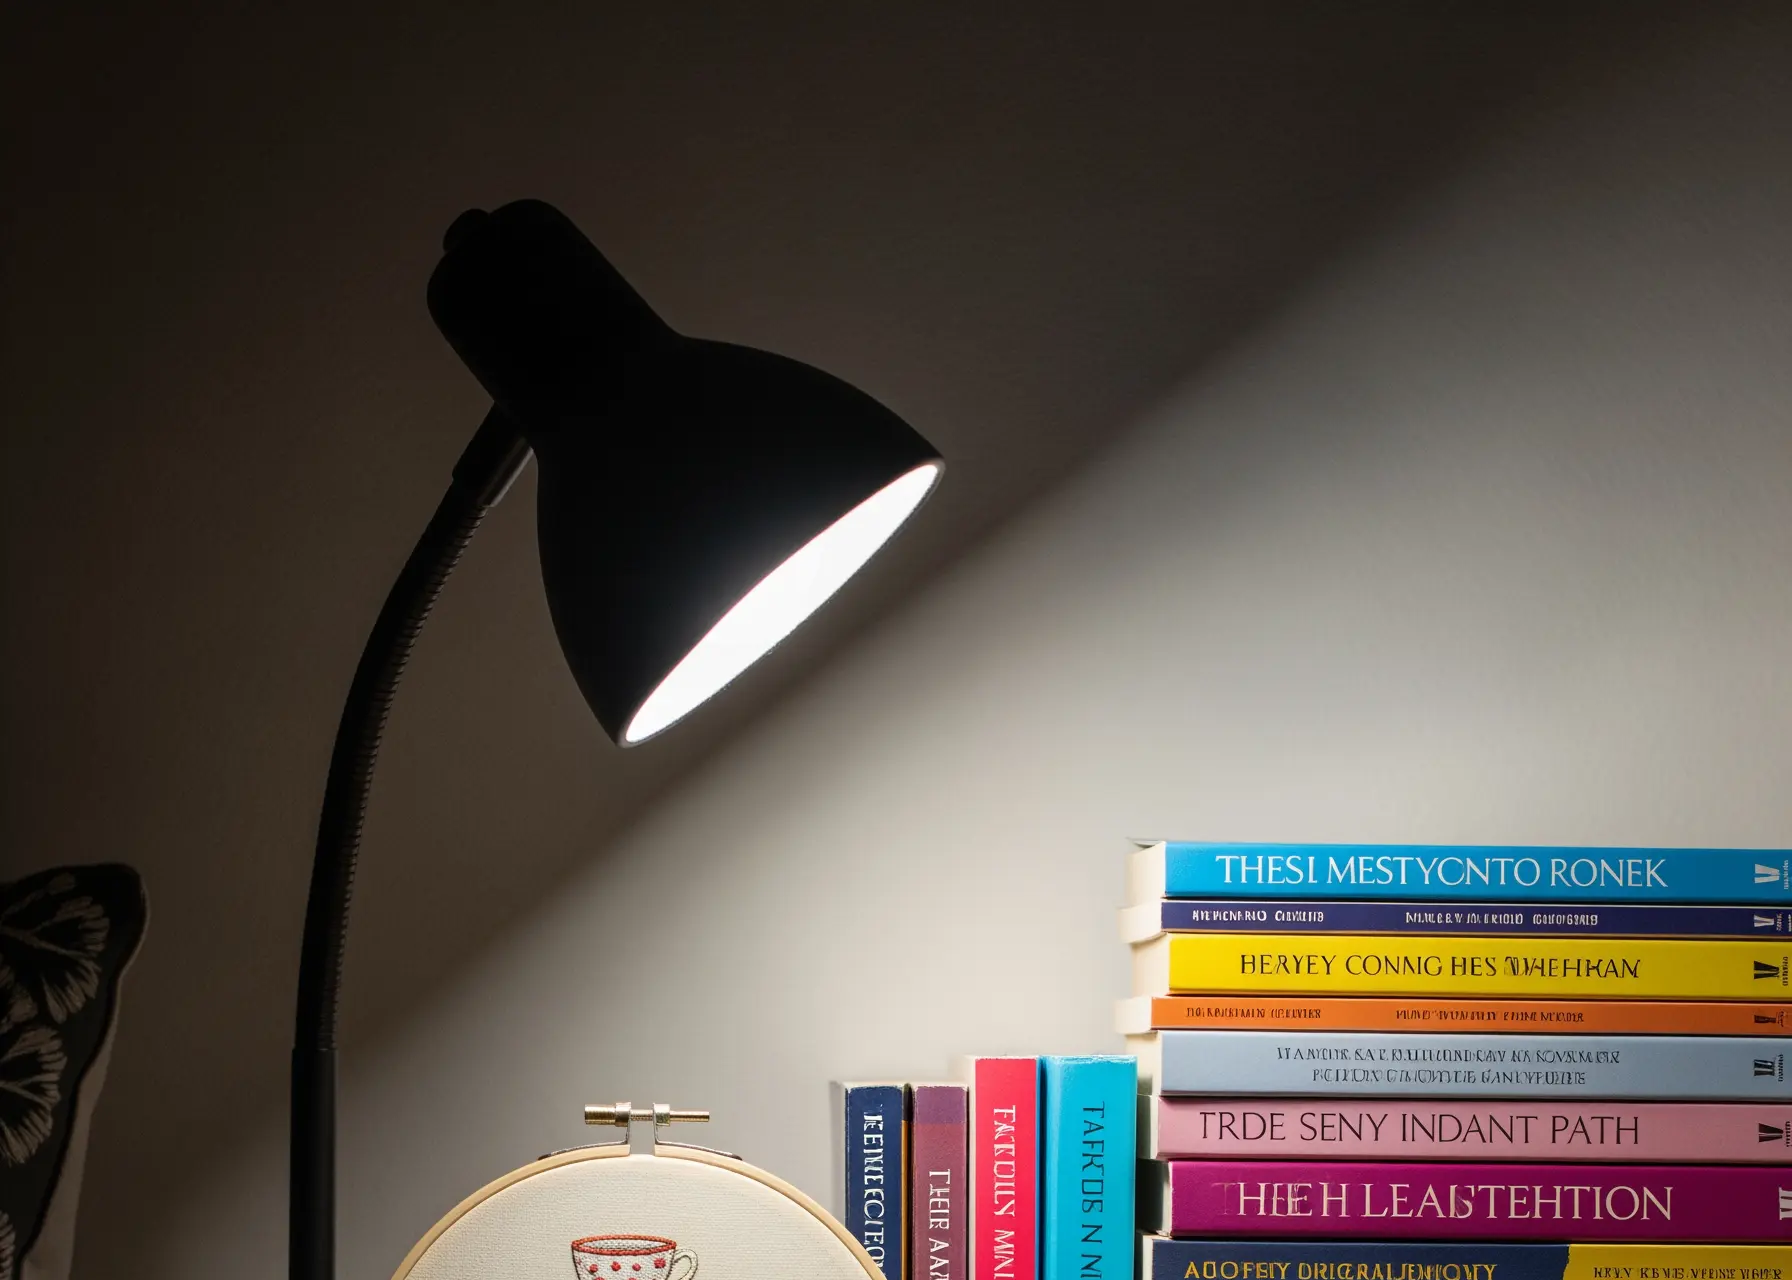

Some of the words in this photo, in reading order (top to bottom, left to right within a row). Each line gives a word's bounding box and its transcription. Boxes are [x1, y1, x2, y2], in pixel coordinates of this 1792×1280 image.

[1550, 858, 1668, 888] RONEK
[1451, 956, 1497, 977] HES
[1199, 1111, 1286, 1141] TRDE
[1300, 1112, 1388, 1142] SENY
[1401, 1113, 1538, 1144] INDANT
[1551, 1114, 1639, 1145] PATH
